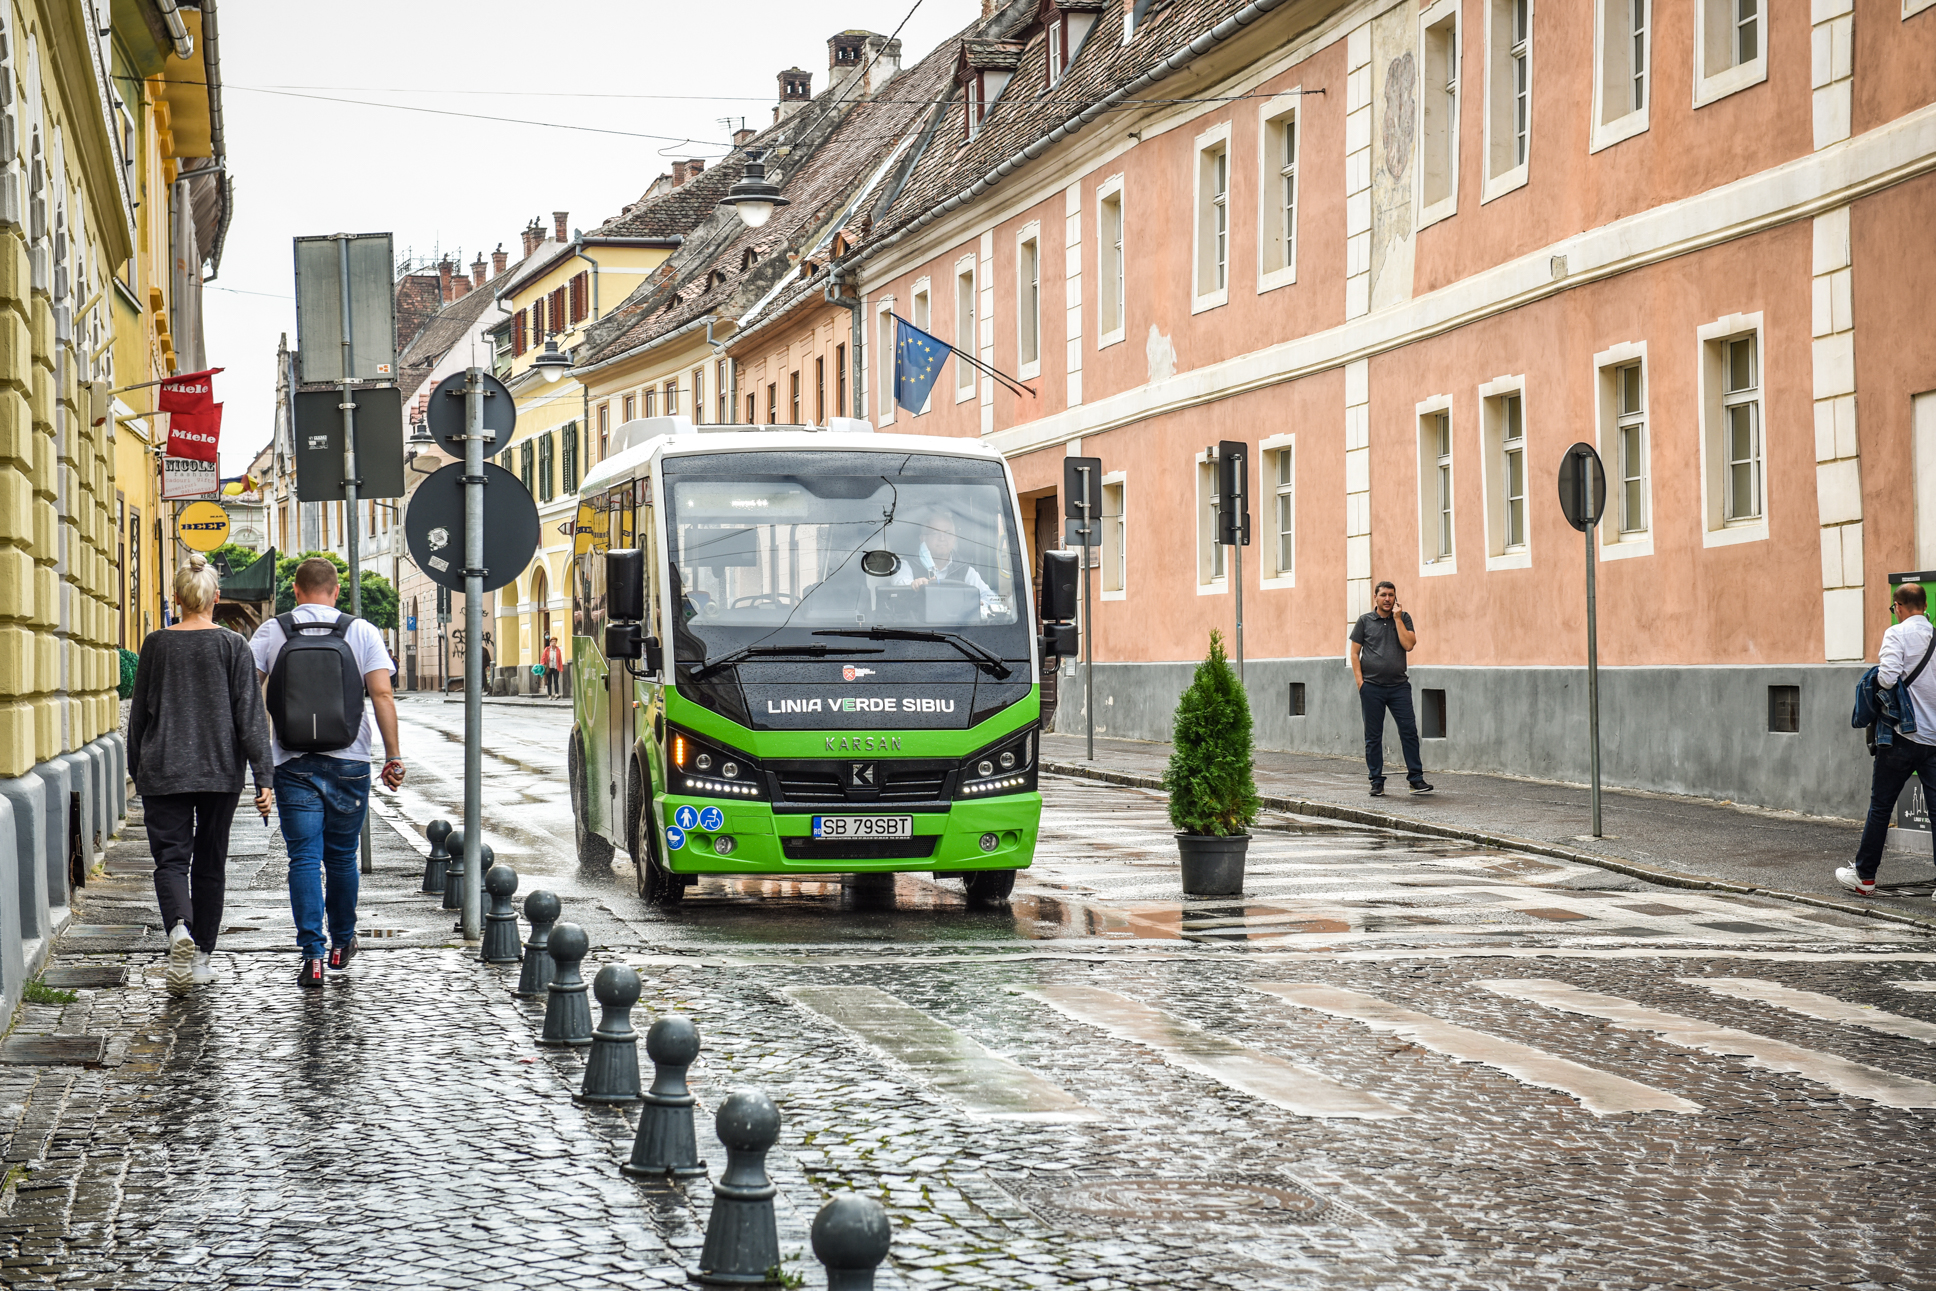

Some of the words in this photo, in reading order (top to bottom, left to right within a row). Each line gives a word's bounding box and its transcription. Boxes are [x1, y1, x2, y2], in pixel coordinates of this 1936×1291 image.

[163, 383, 208, 393] Miele
[171, 429, 216, 443] Miele
[165, 460, 215, 472] NICOLE
[181, 522, 226, 531] BEEP
[767, 699, 822, 713] LINIA
[828, 698, 897, 712] VERDE
[902, 698, 955, 713] SIBIU
[825, 737, 901, 751] KARSAN
[823, 819, 847, 835] SB
[854, 818, 908, 835] 79SBT
